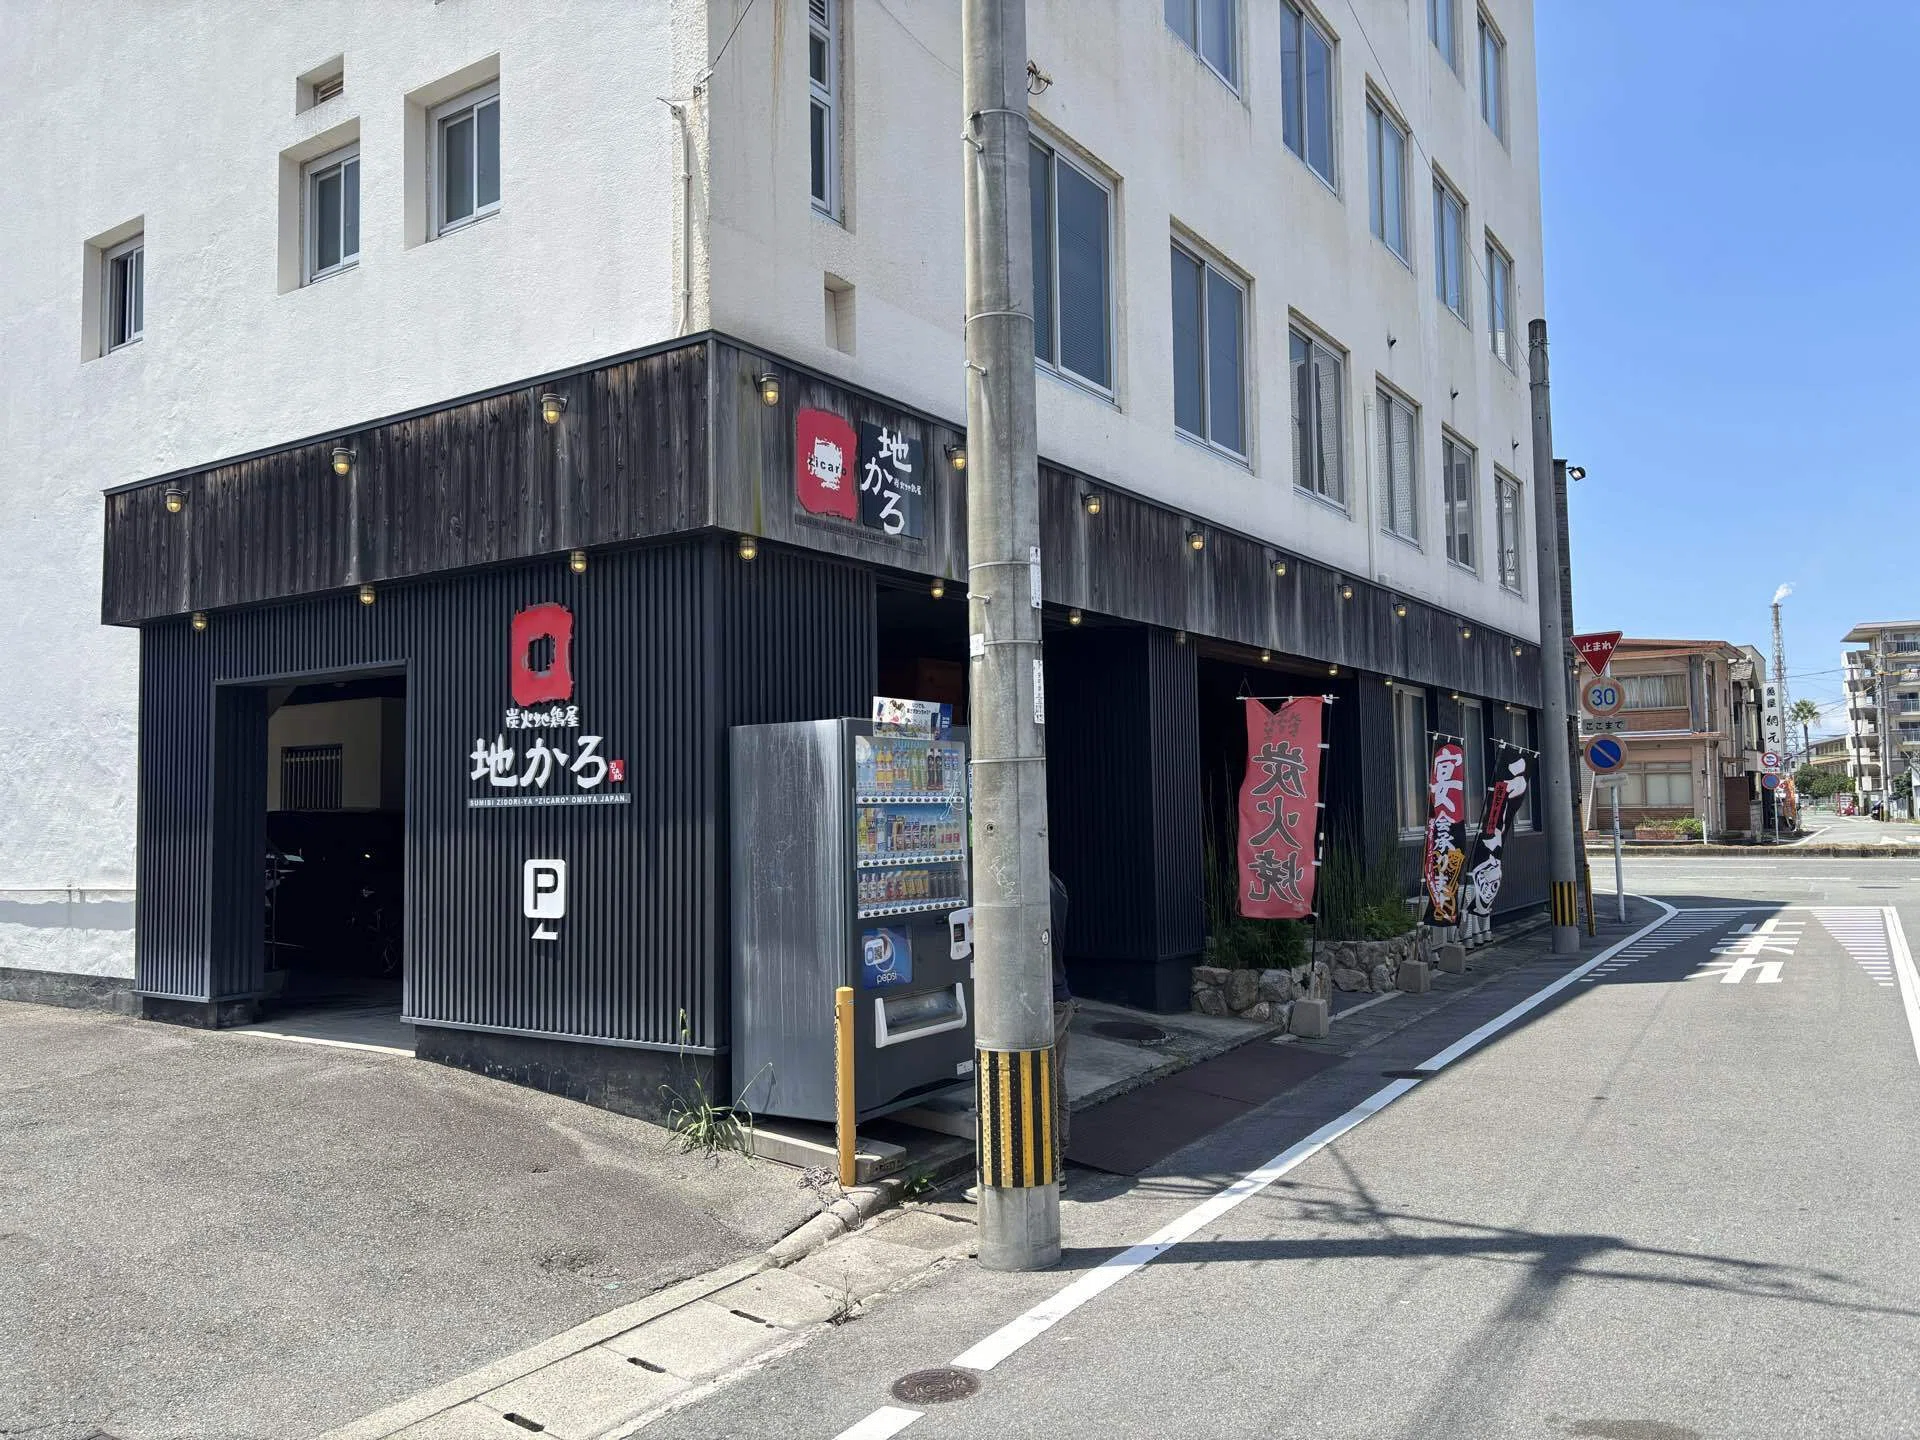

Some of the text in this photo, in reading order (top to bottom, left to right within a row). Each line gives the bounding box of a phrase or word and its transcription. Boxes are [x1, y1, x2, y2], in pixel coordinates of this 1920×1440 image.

[808, 456, 847, 477] zicaro
[861, 426, 912, 535] 地かろ
[1582, 640, 1613, 653] 止まれ
[1592, 688, 1616, 707] 30
[506, 705, 579, 729] 炭火地鶏屋
[1586, 720, 1625, 731] ここまで
[470, 734, 608, 790] 地かろ
[571, 795, 598, 804] OMUTA
[532, 867, 559, 911] P
[1684, 918, 1807, 984] 止まれ
[876, 970, 897, 984] pepsi
